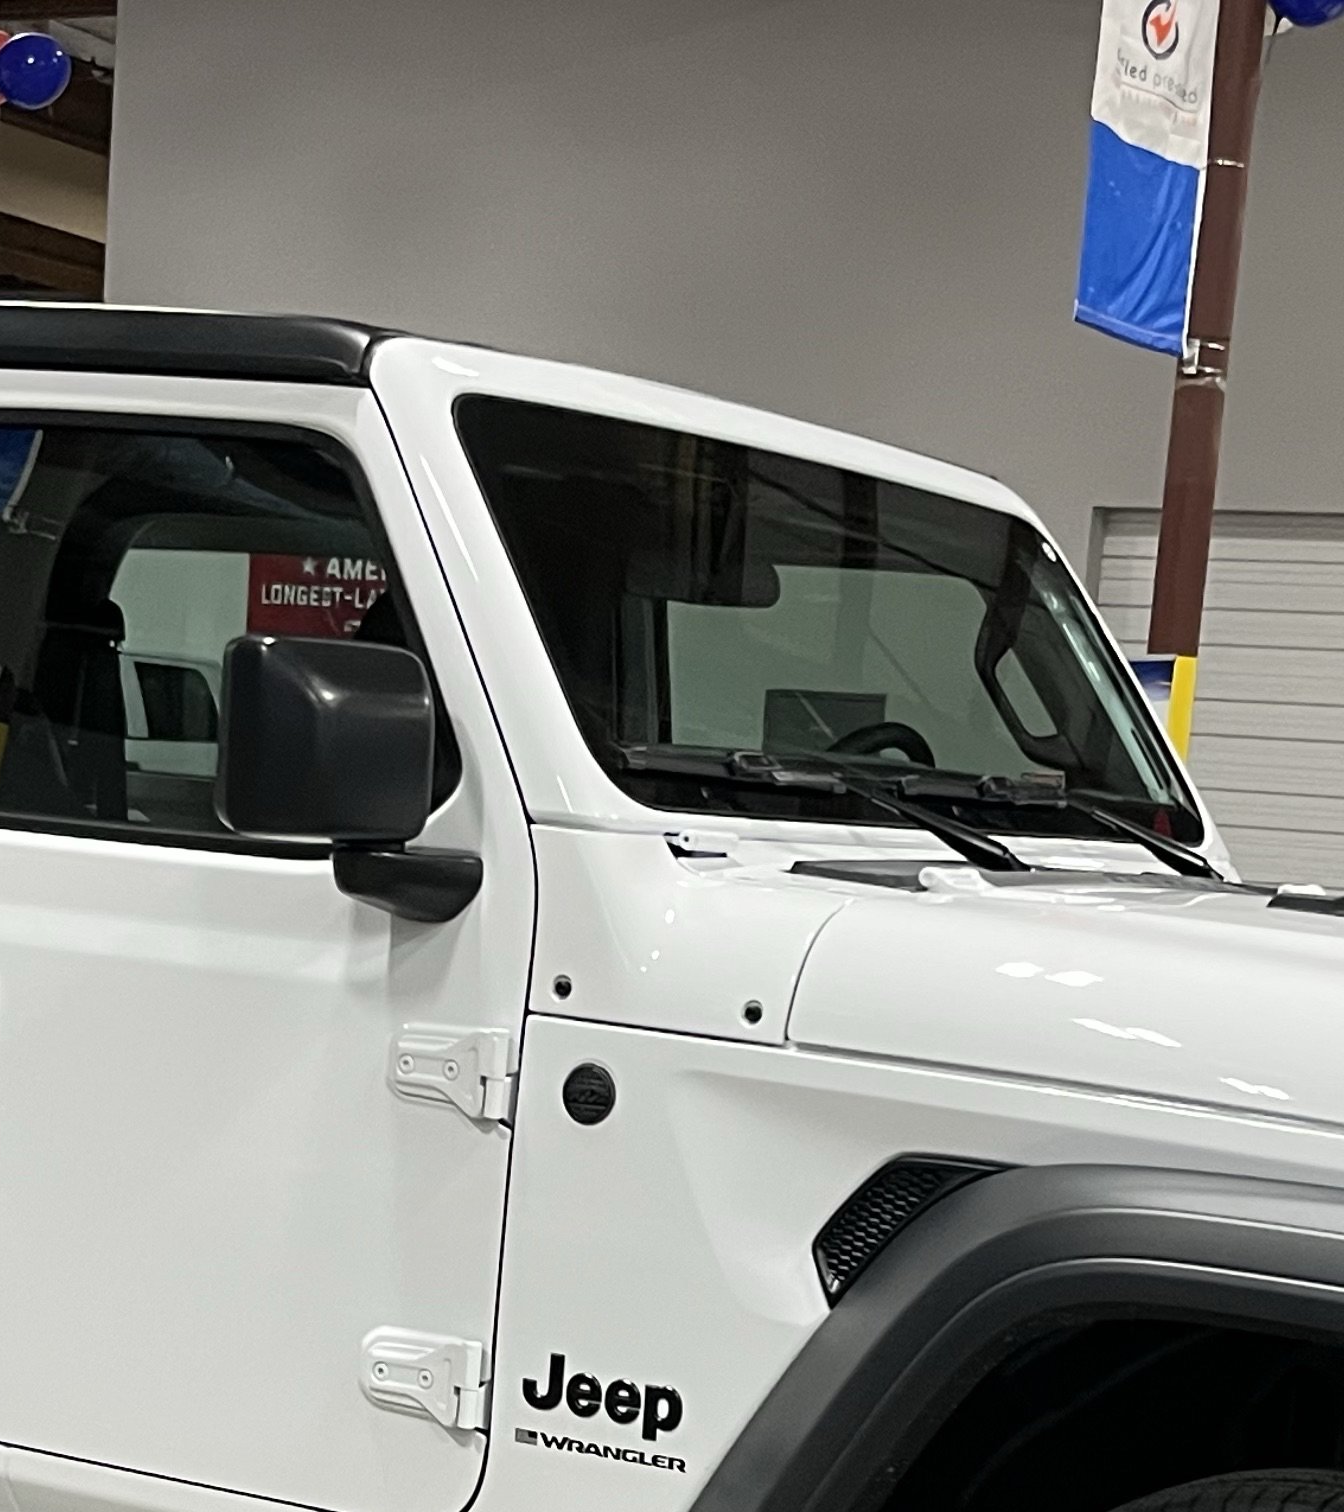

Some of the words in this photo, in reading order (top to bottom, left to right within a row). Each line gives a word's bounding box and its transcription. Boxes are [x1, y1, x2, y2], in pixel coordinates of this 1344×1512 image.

[260, 583, 387, 610] LONGEST-LA
[522, 1353, 684, 1441] Jeep
[539, 1432, 687, 1473] WRANGLER
